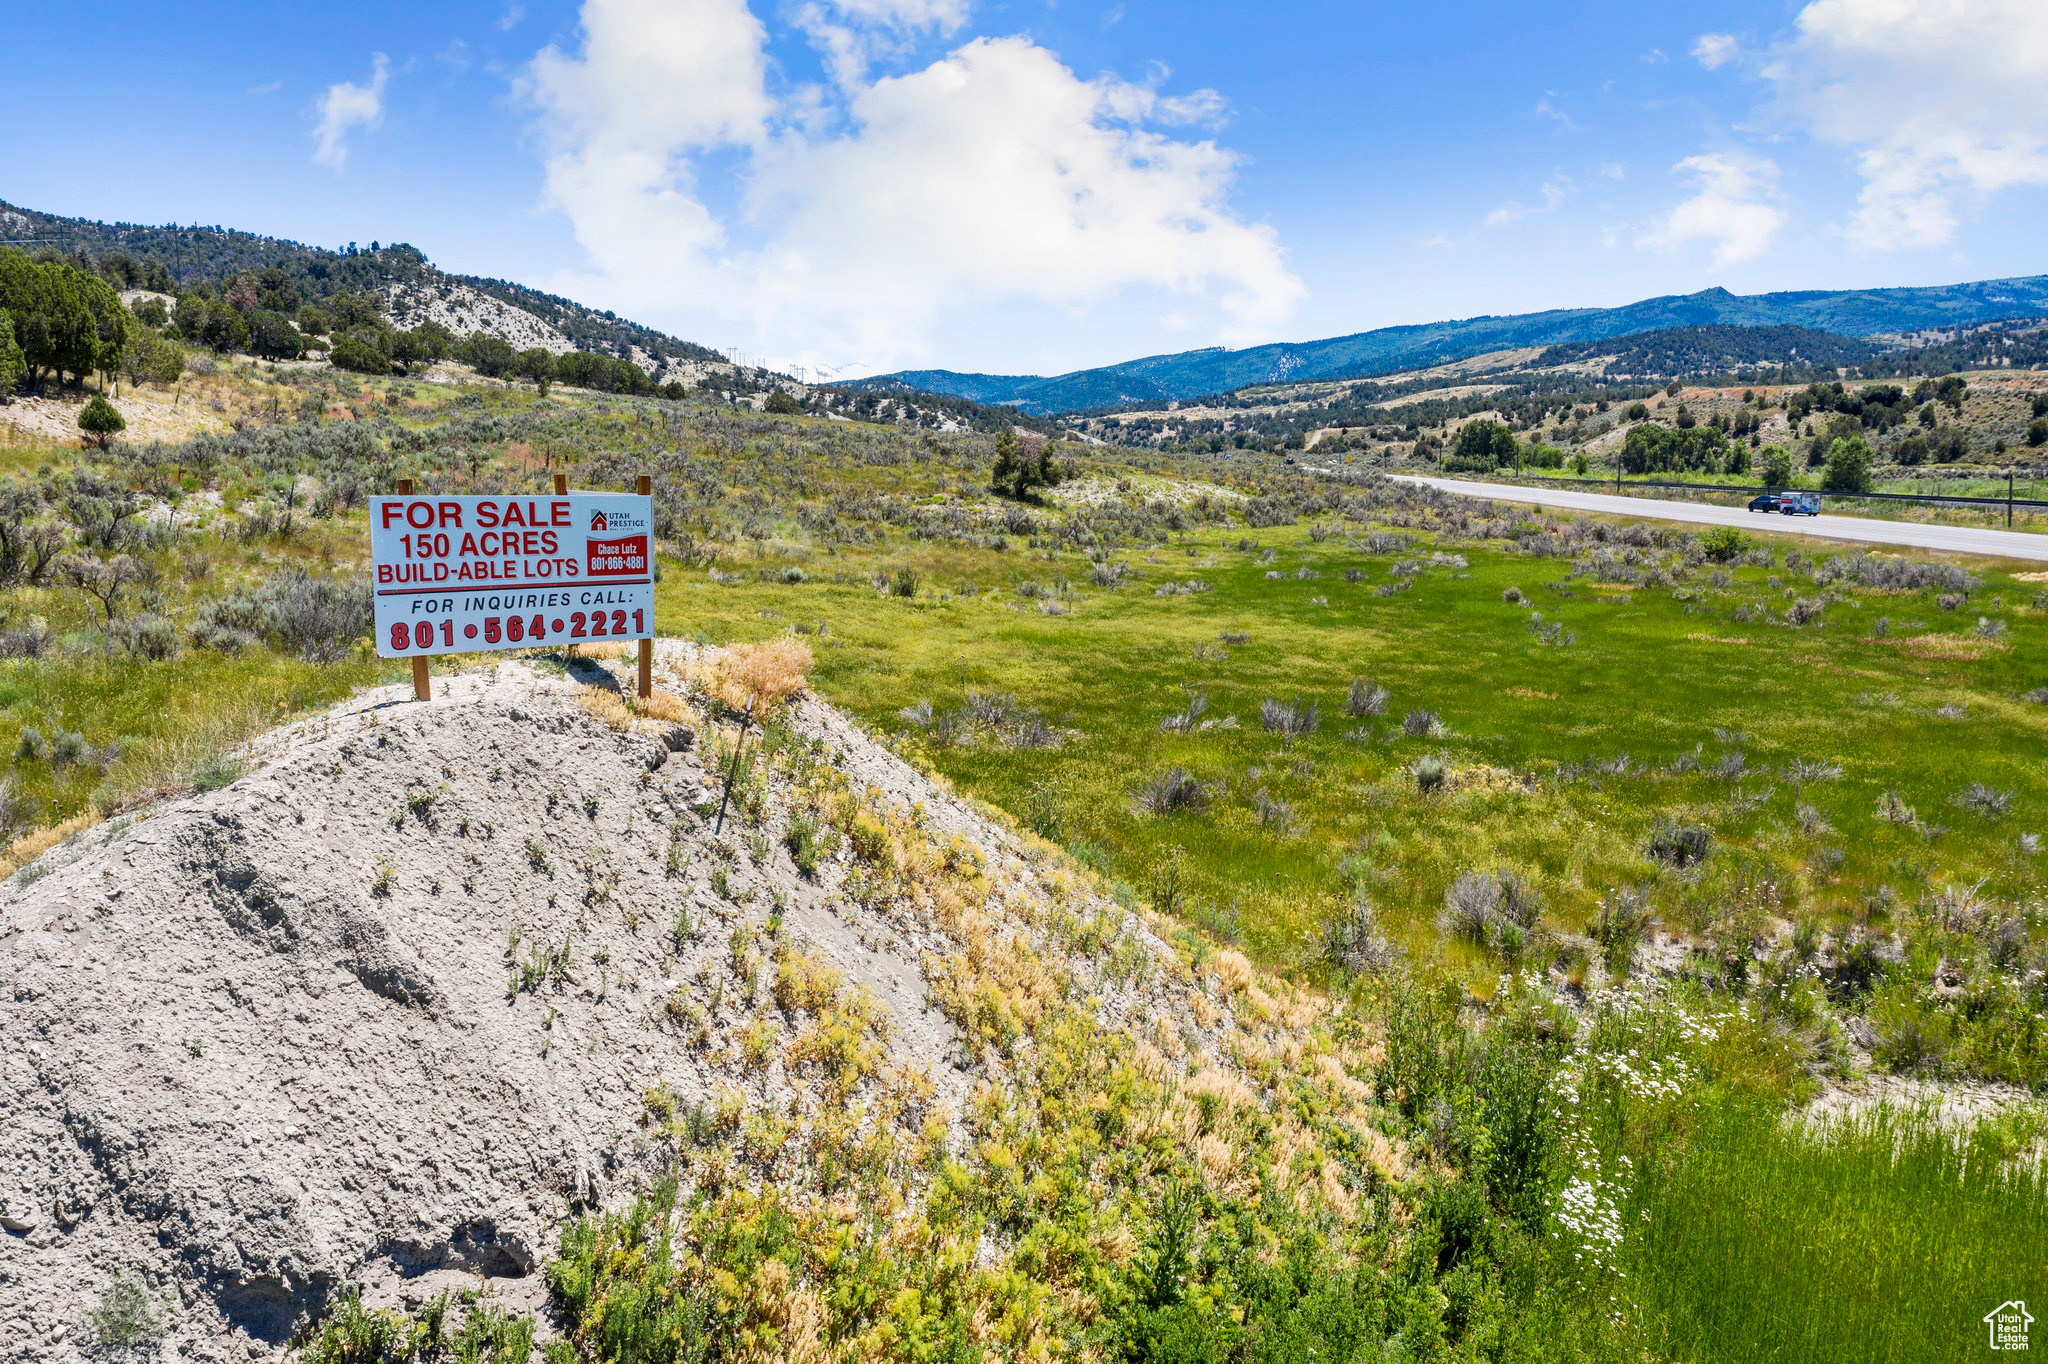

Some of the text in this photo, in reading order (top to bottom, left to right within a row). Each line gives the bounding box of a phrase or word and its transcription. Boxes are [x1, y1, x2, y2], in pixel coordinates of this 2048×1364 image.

[381, 501, 571, 529] FOR SALE
[399, 531, 558, 559] 150 ACRES
[598, 544, 637, 554] Chace Lutz
[378, 558, 579, 584] BUILD-ABLE LOTS
[411, 591, 633, 614] FOR INQUIRIES CALL:
